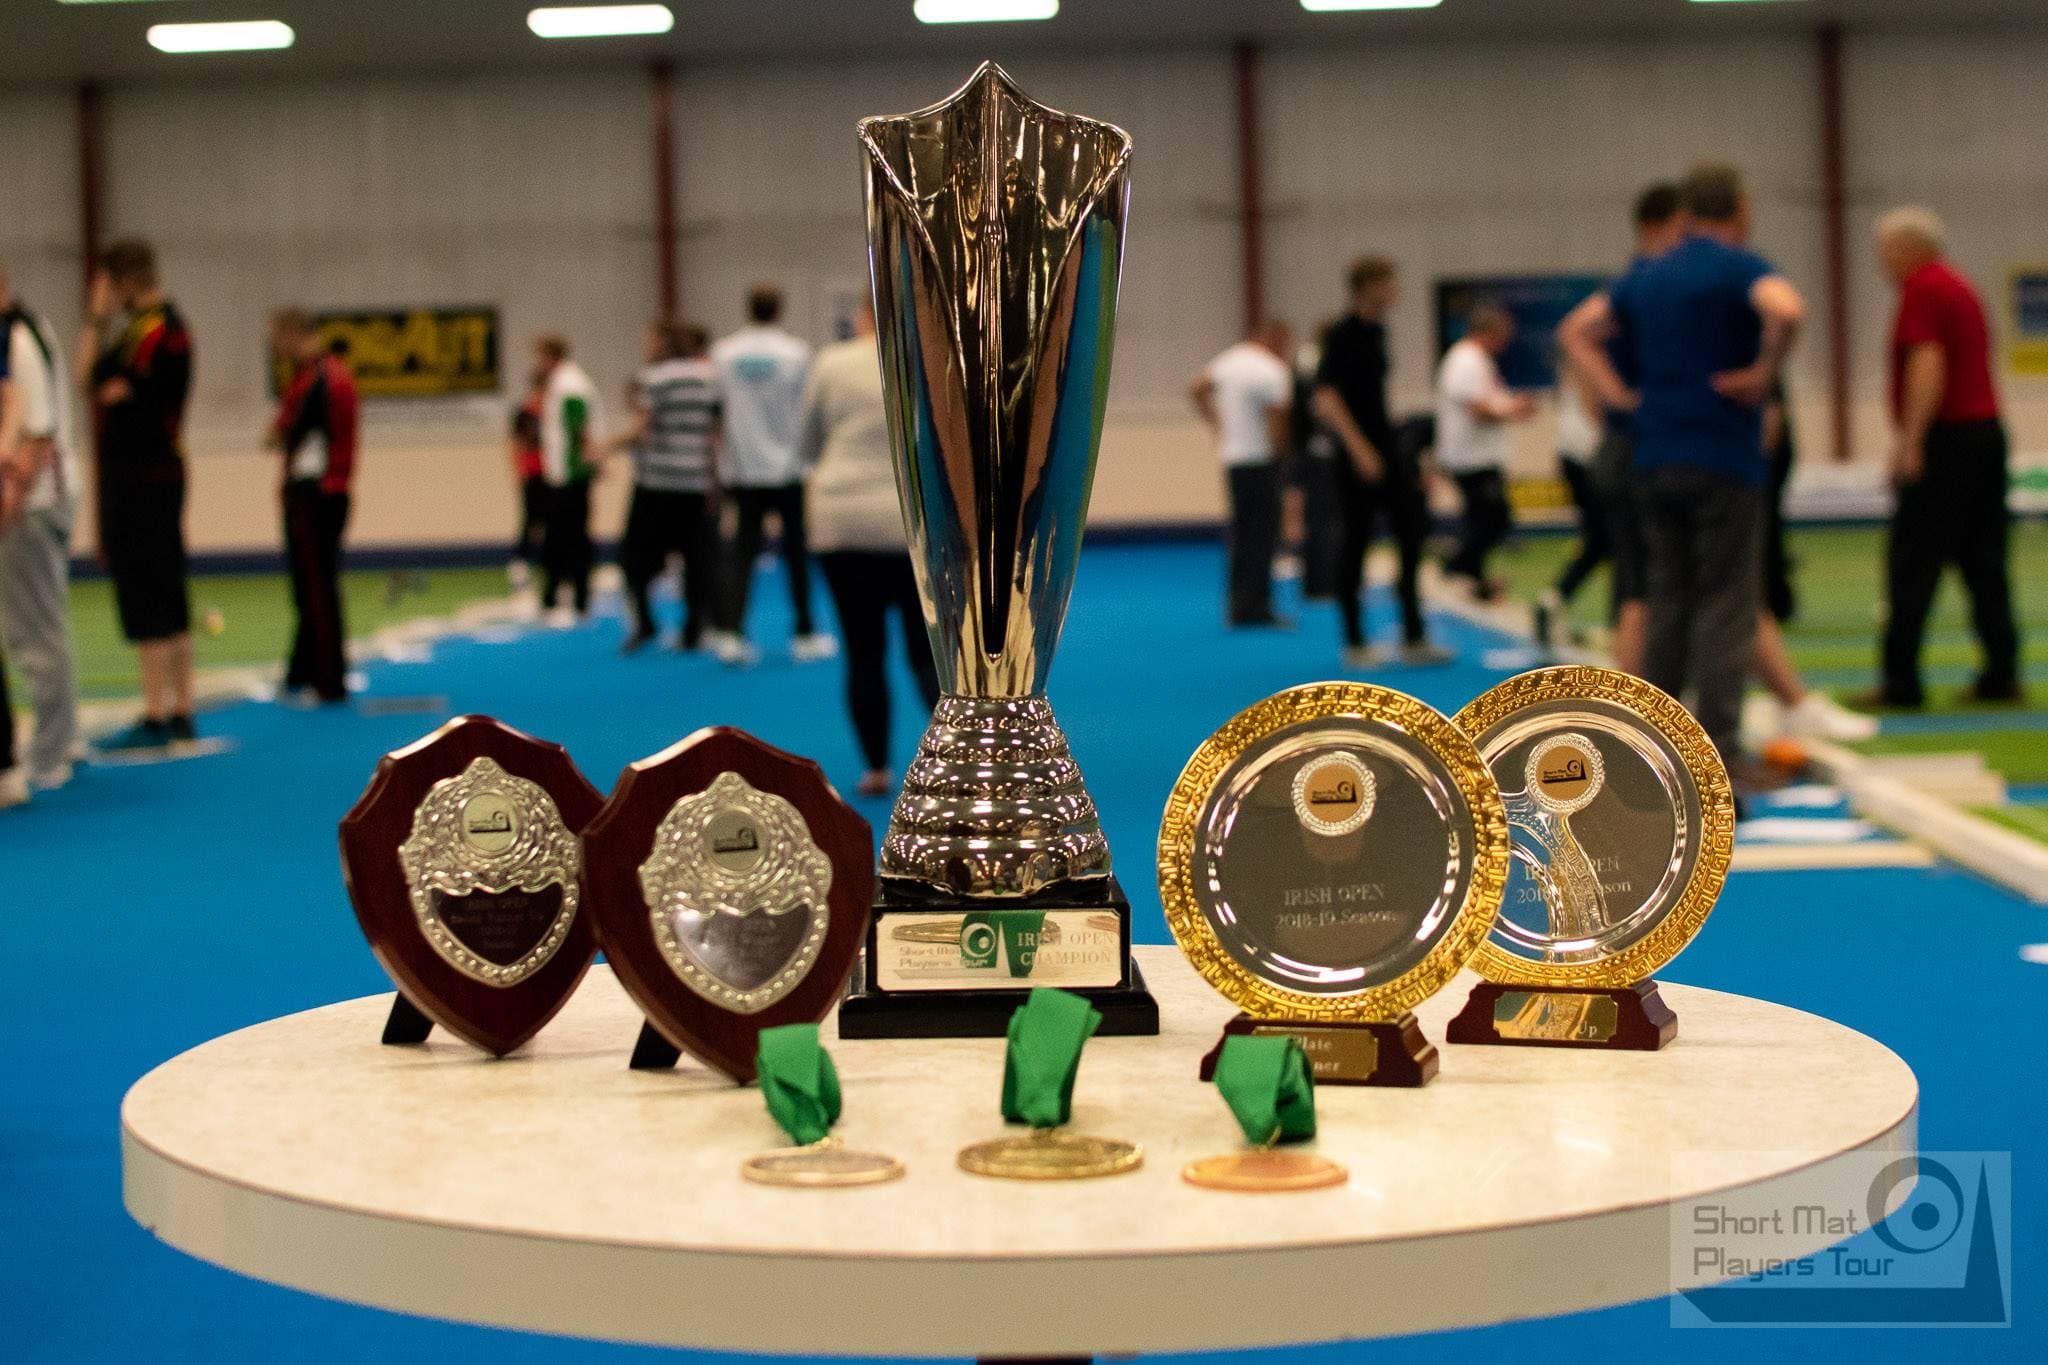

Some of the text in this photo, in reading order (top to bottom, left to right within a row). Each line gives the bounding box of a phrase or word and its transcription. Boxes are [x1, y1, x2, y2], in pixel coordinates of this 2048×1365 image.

[1284, 883, 1386, 906] IRISH OPEN
[1069, 931, 1116, 946] OPEN
[1295, 1035, 1333, 1050] late
